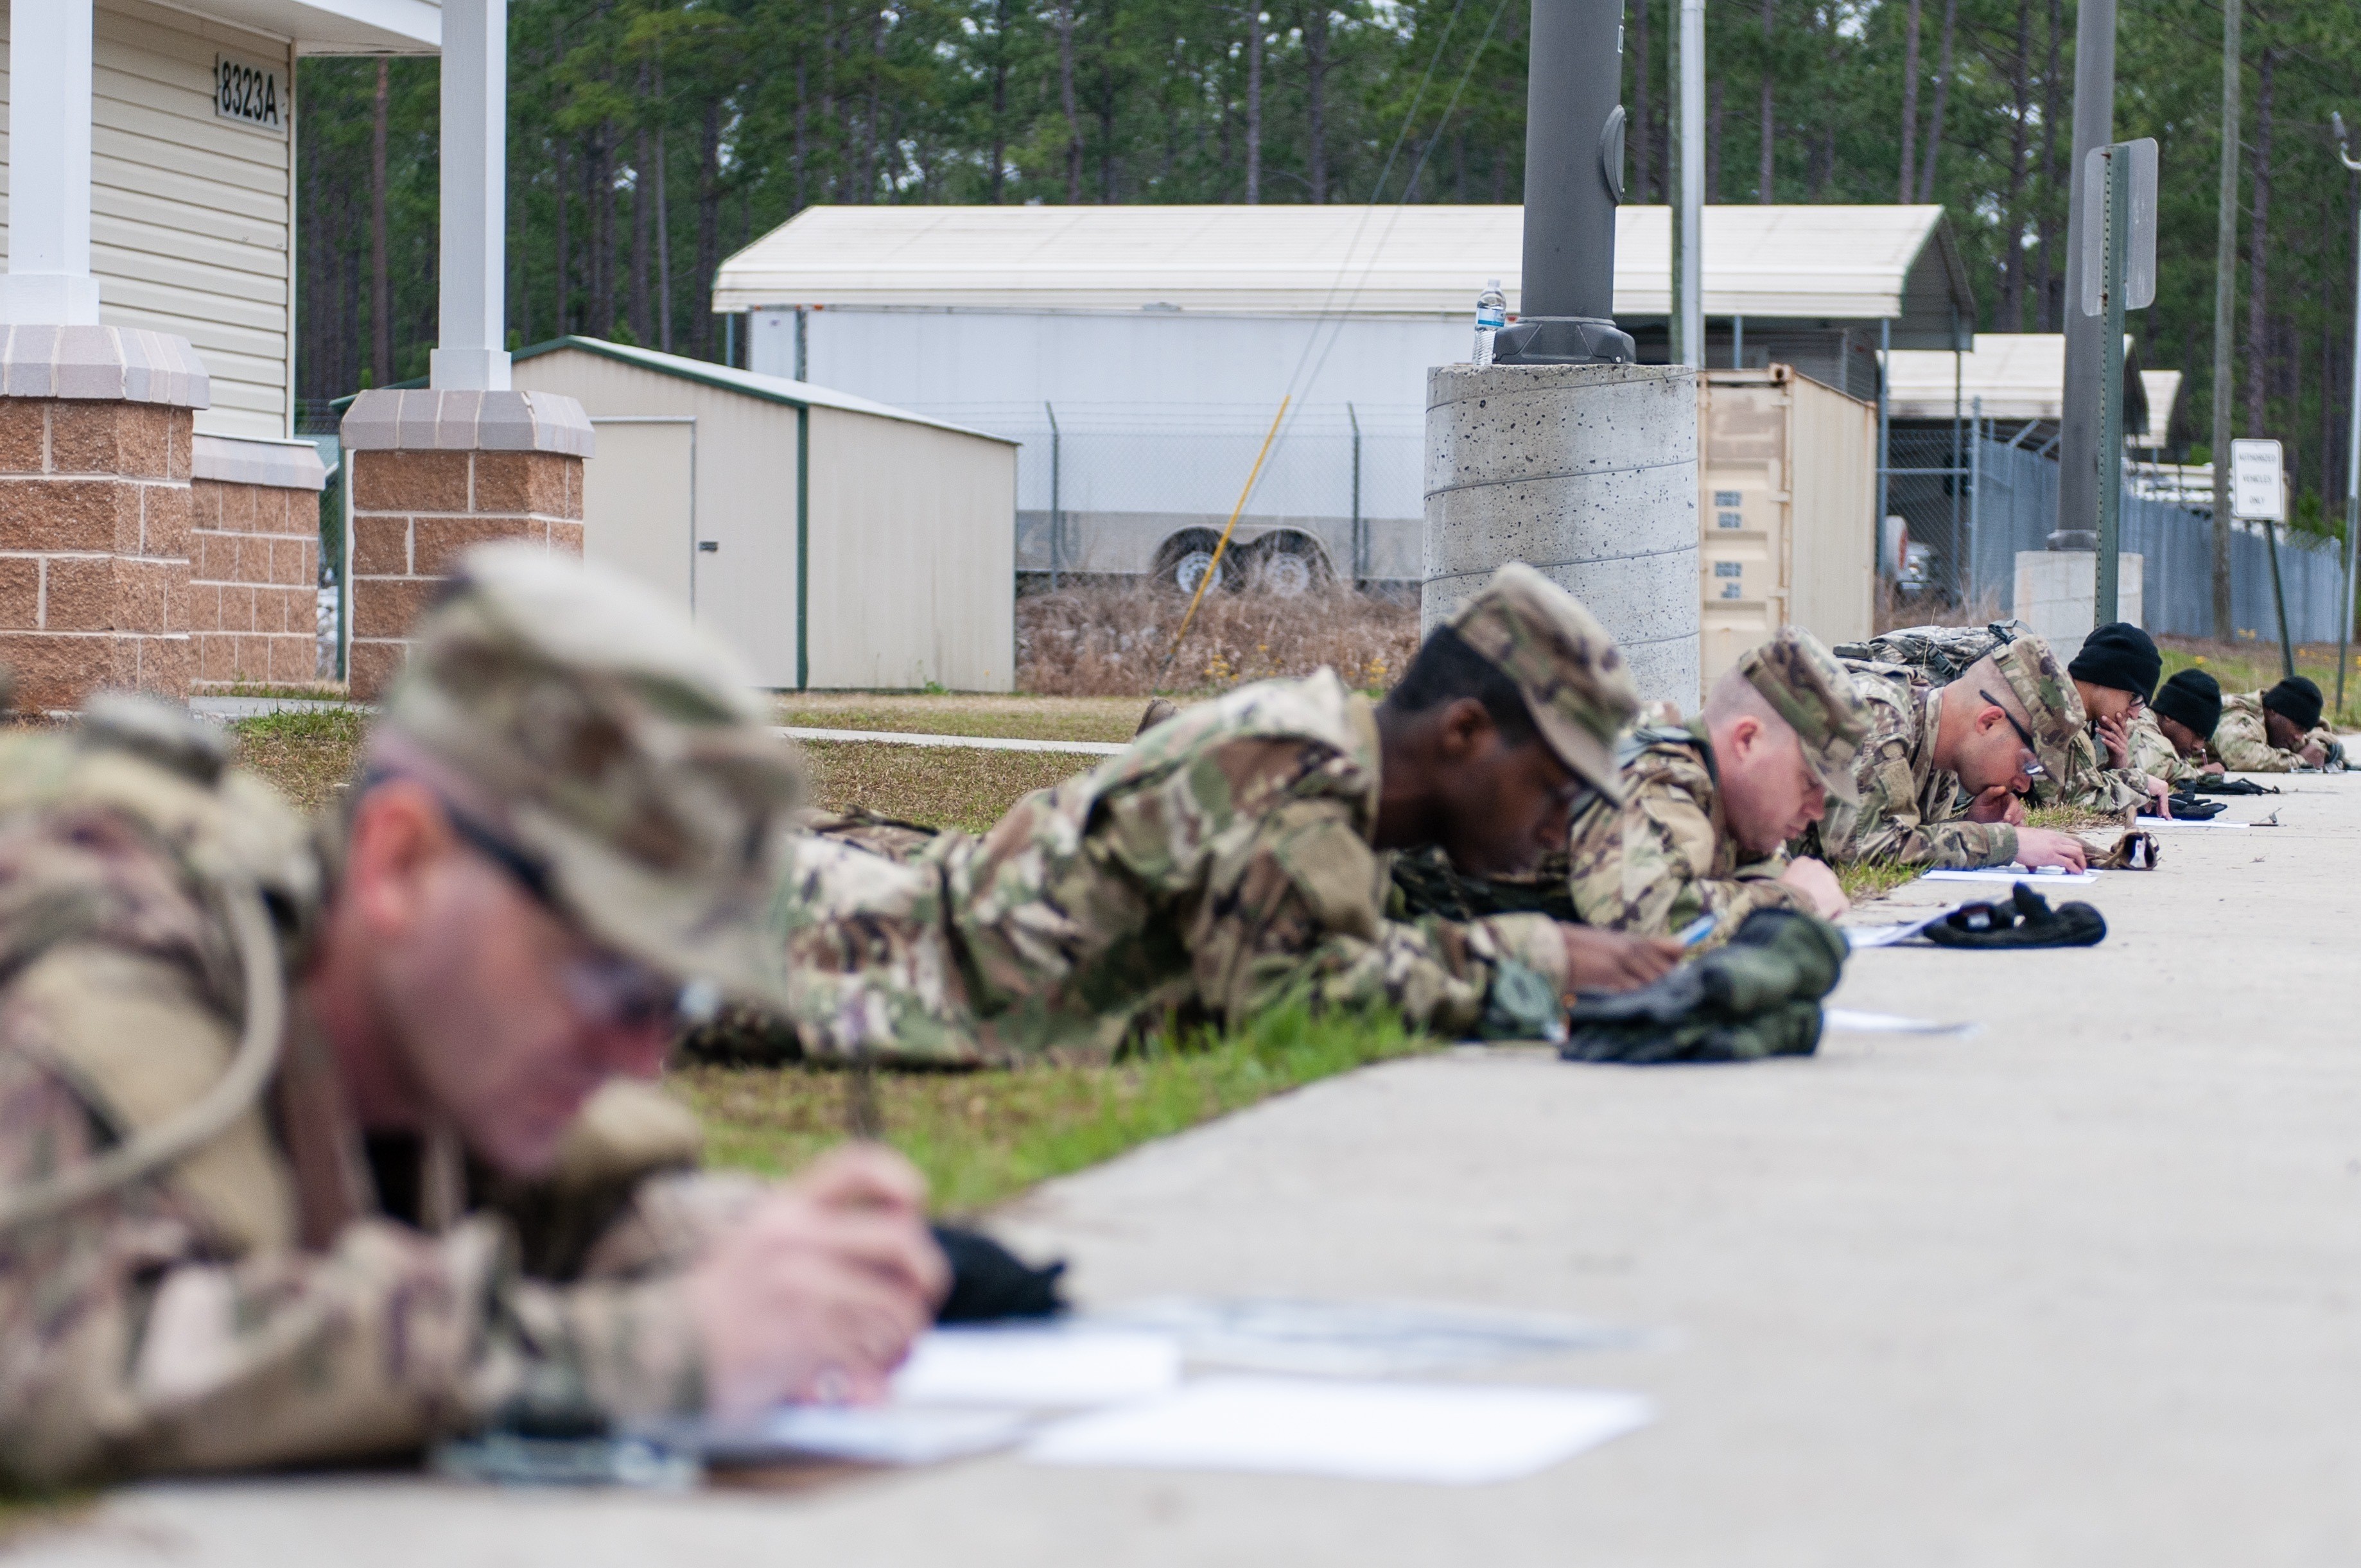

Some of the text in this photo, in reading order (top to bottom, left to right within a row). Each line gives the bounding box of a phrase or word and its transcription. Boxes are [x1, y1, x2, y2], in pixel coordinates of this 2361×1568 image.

[222, 60, 278, 125] 8323A
[2238, 453, 2277, 462] AUTHORIZED
[2243, 474, 2272, 483] VEHICLES
[2249, 495, 2265, 506] ONLY
